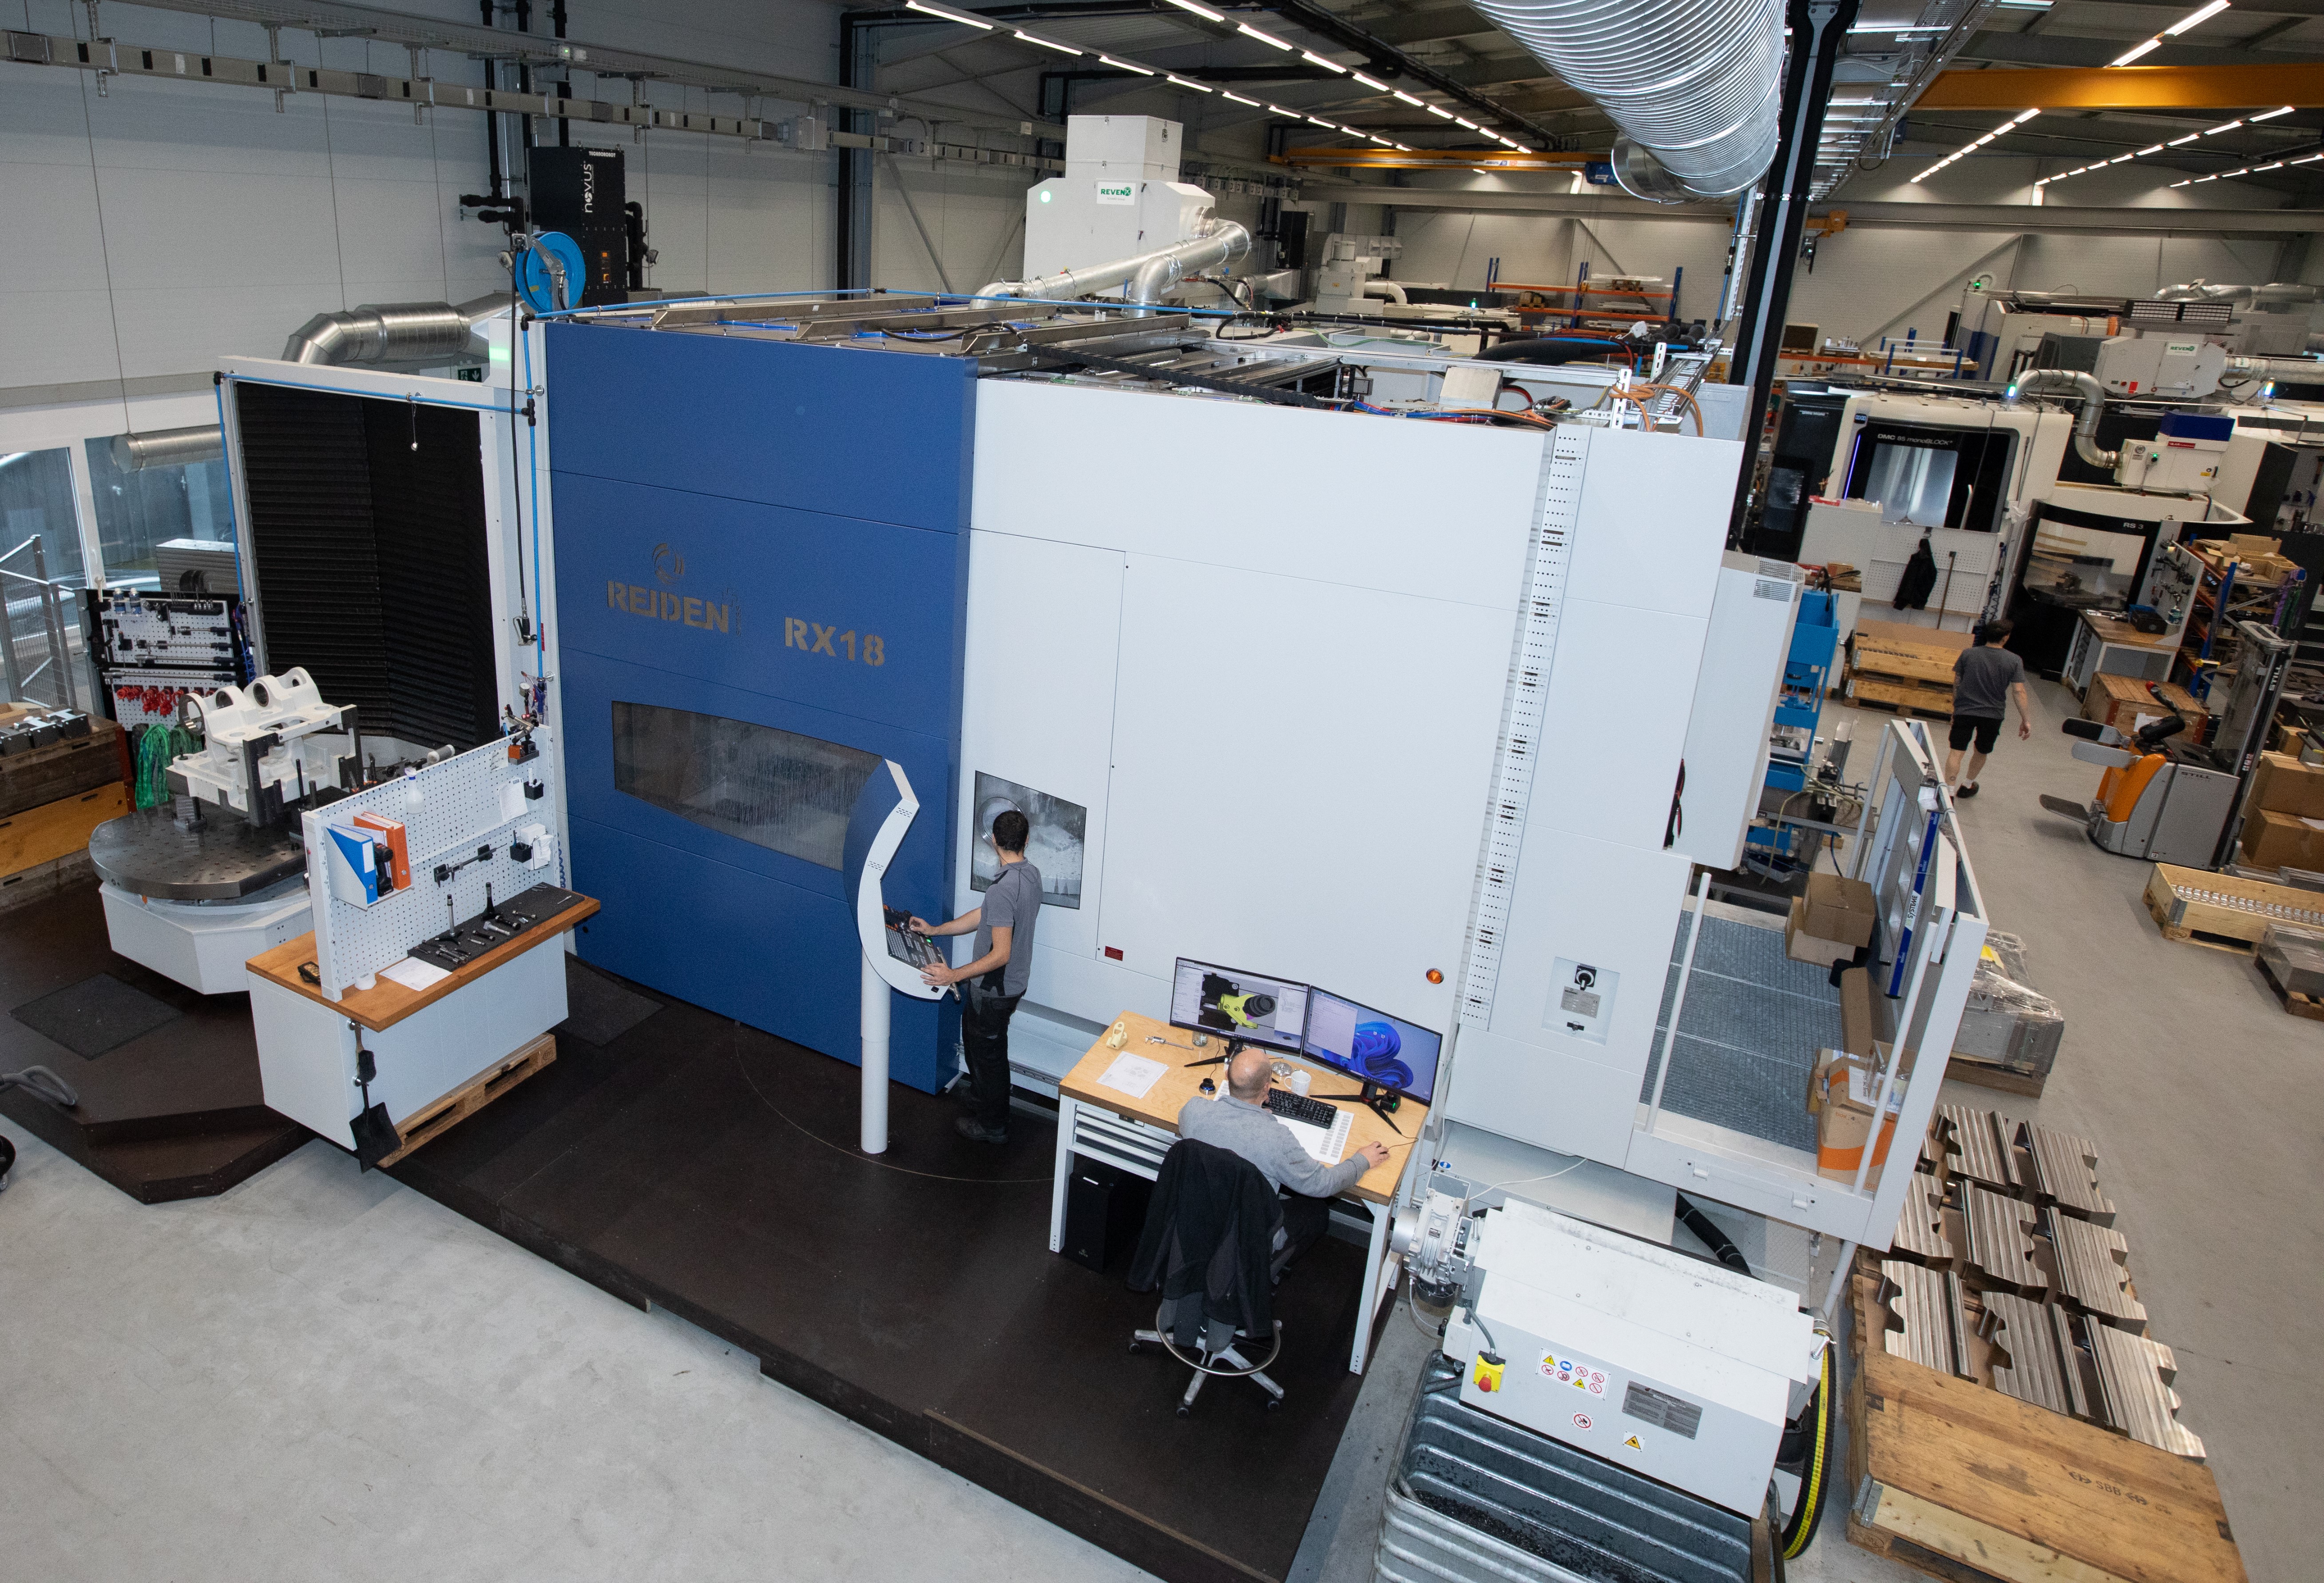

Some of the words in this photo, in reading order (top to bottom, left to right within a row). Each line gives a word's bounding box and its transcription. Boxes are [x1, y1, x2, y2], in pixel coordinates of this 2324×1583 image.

[607, 580, 730, 633] REIDEN
[785, 616, 885, 667] RX18
[2268, 665, 2283, 691] STILL
[1907, 894, 1918, 919] SYSTEME
[2095, 1480, 2122, 1496] SBB
